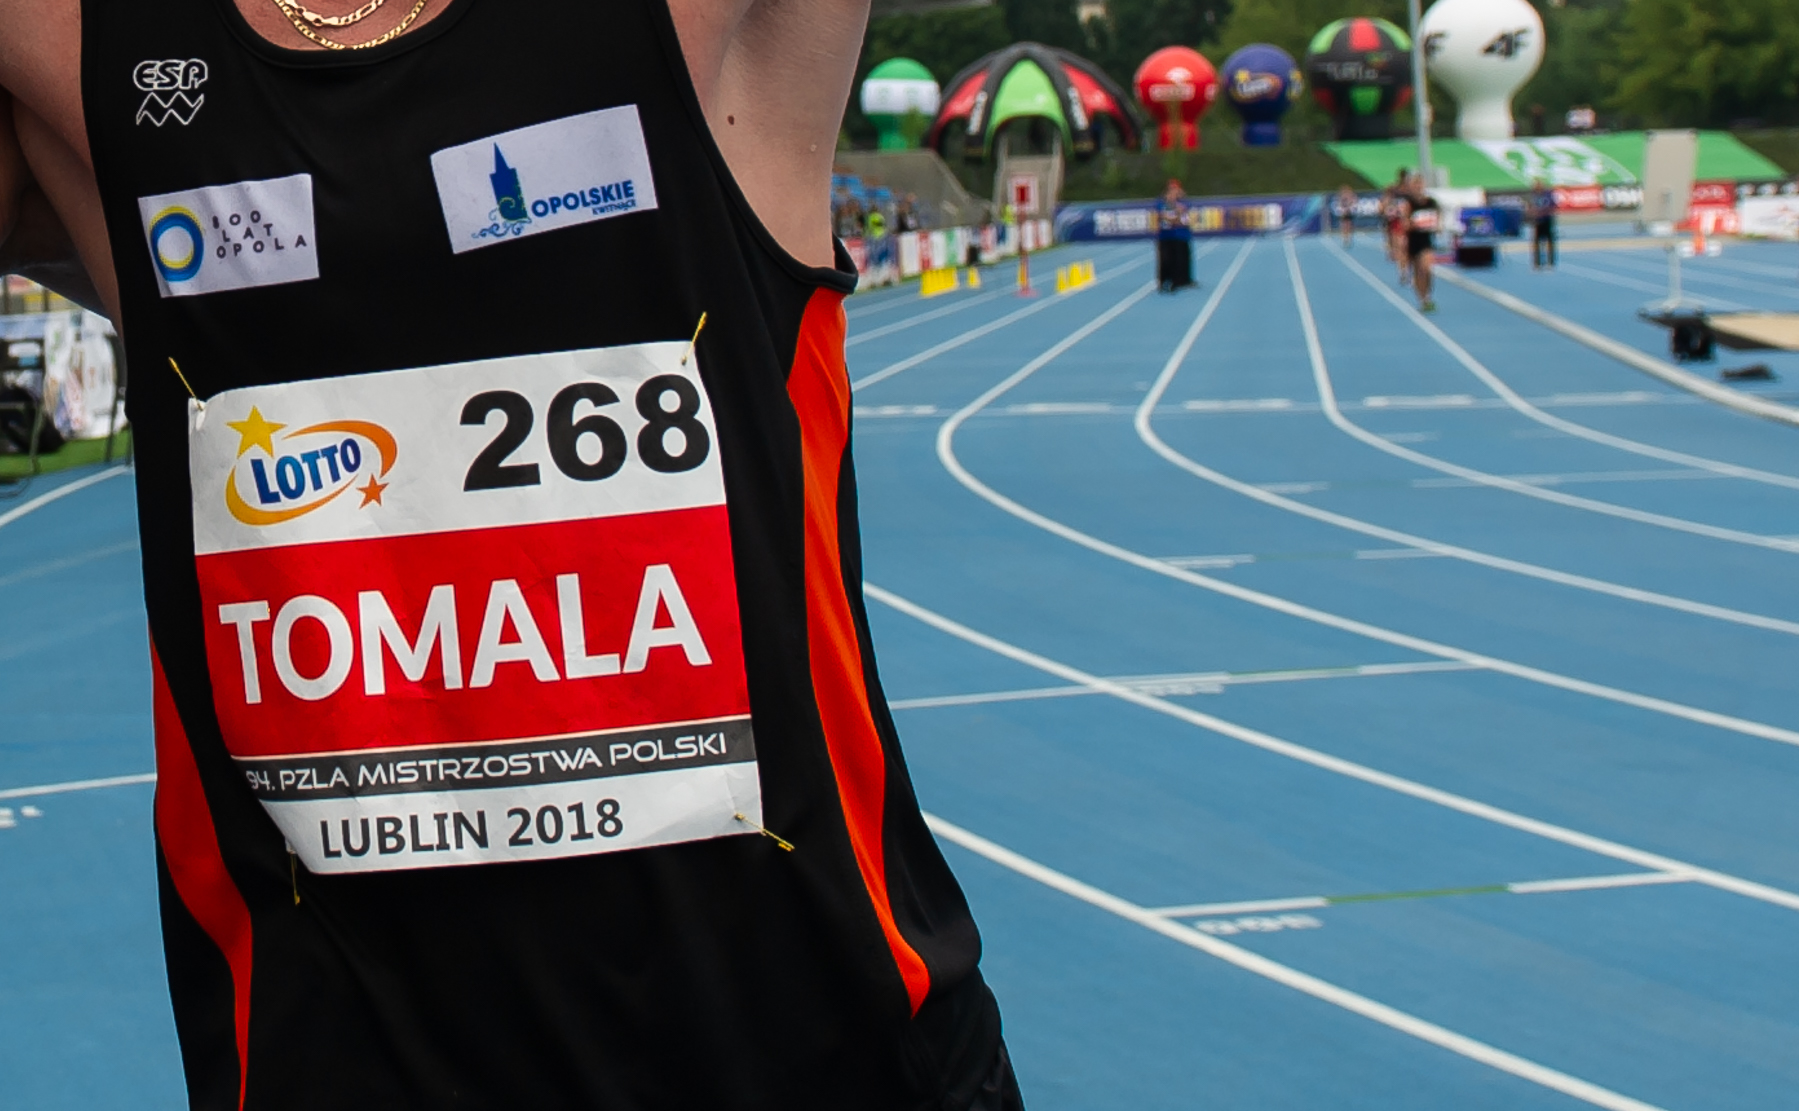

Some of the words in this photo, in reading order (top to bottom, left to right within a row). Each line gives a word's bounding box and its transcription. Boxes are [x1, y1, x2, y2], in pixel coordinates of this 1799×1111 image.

[212, 210, 261, 229] 100
[531, 179, 635, 218] OPOLSKIE
[216, 235, 307, 259] OPOLA
[222, 223, 273, 242] LAT
[458, 373, 711, 493] 268
[249, 437, 362, 505] LOTTO
[218, 563, 713, 705] TOMALA
[279, 767, 350, 791] PZLA
[357, 747, 603, 788] MISTRZOSTWA
[608, 732, 727, 766] POLSKI
[320, 810, 489, 859] LUBLIN
[506, 798, 624, 847] 2018
